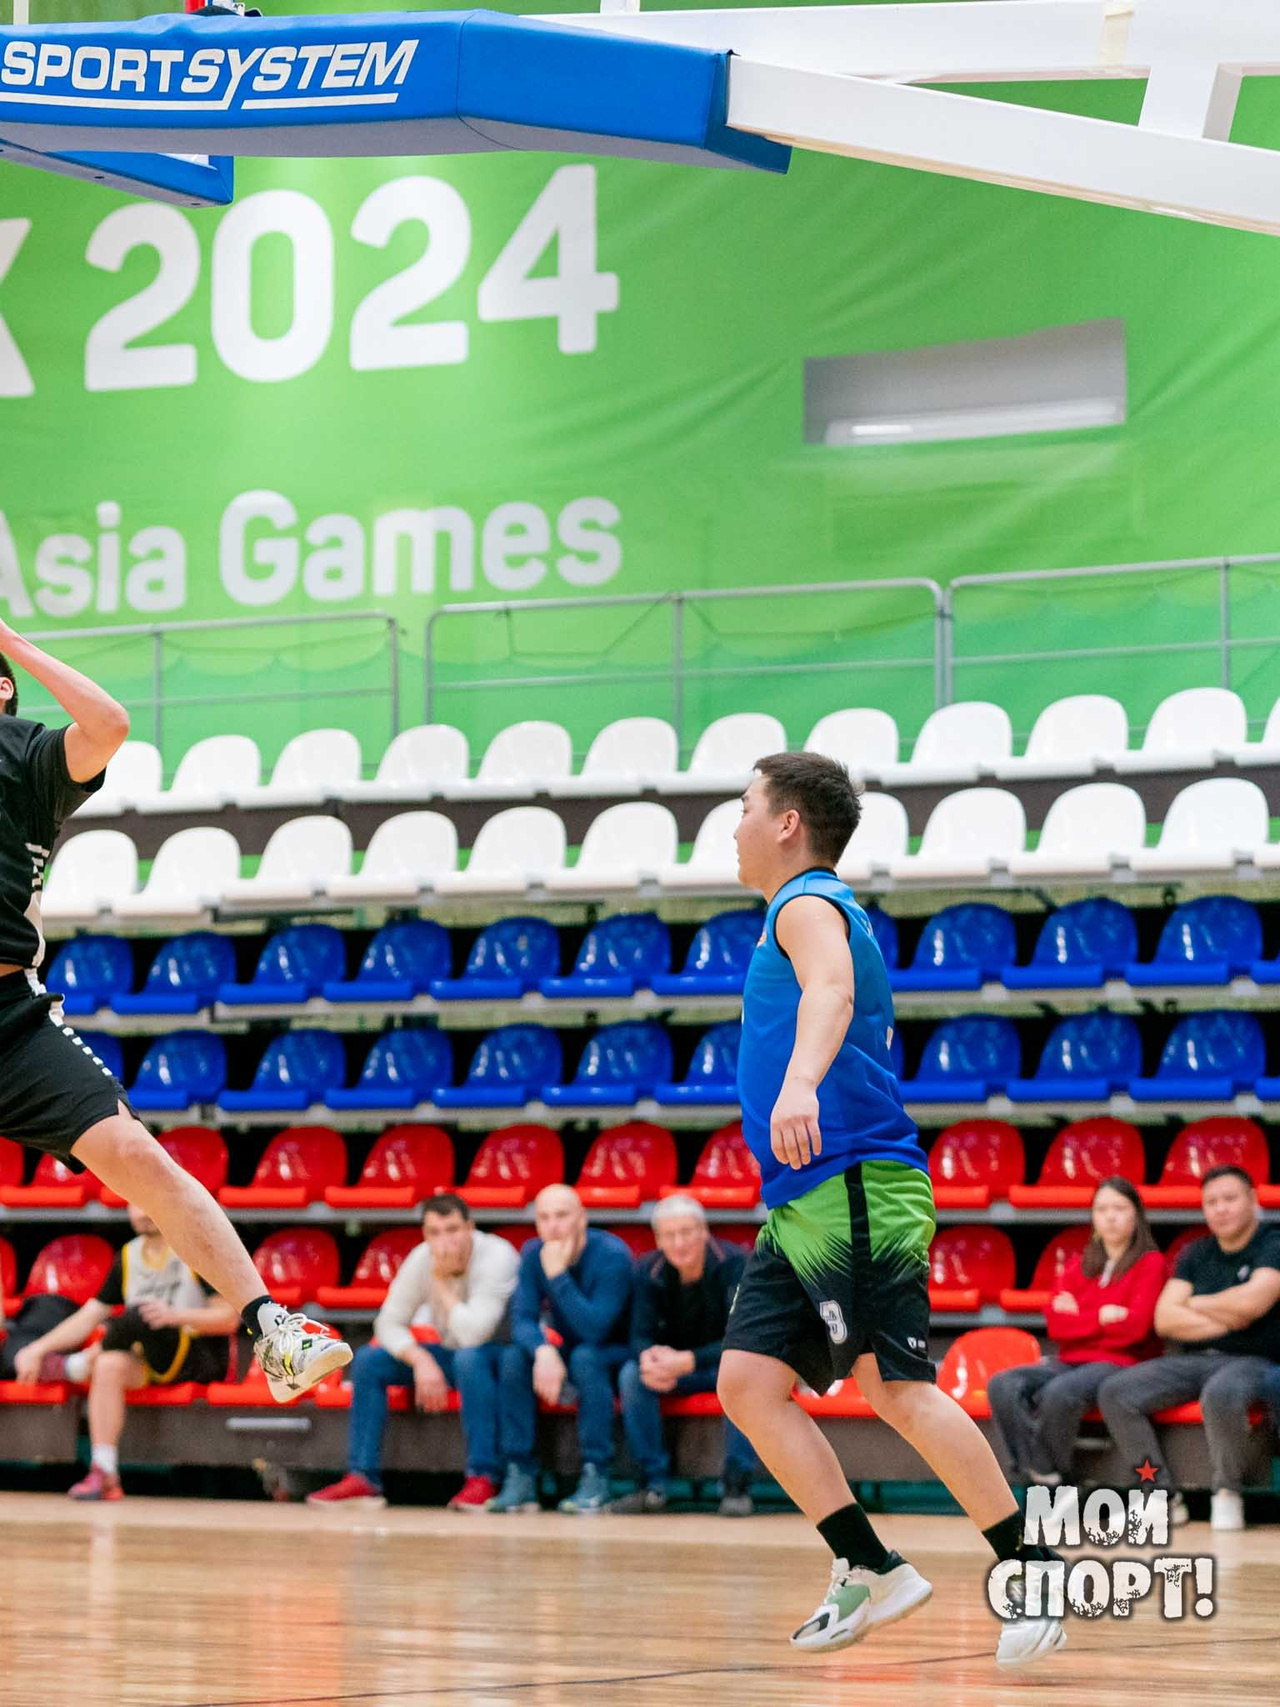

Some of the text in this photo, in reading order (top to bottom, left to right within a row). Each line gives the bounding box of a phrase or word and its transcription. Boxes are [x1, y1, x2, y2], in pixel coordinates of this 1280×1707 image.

[0, 39, 420, 110] SPORTSYSTEM
[84, 164, 619, 392] 2024
[219, 489, 622, 606] Games
